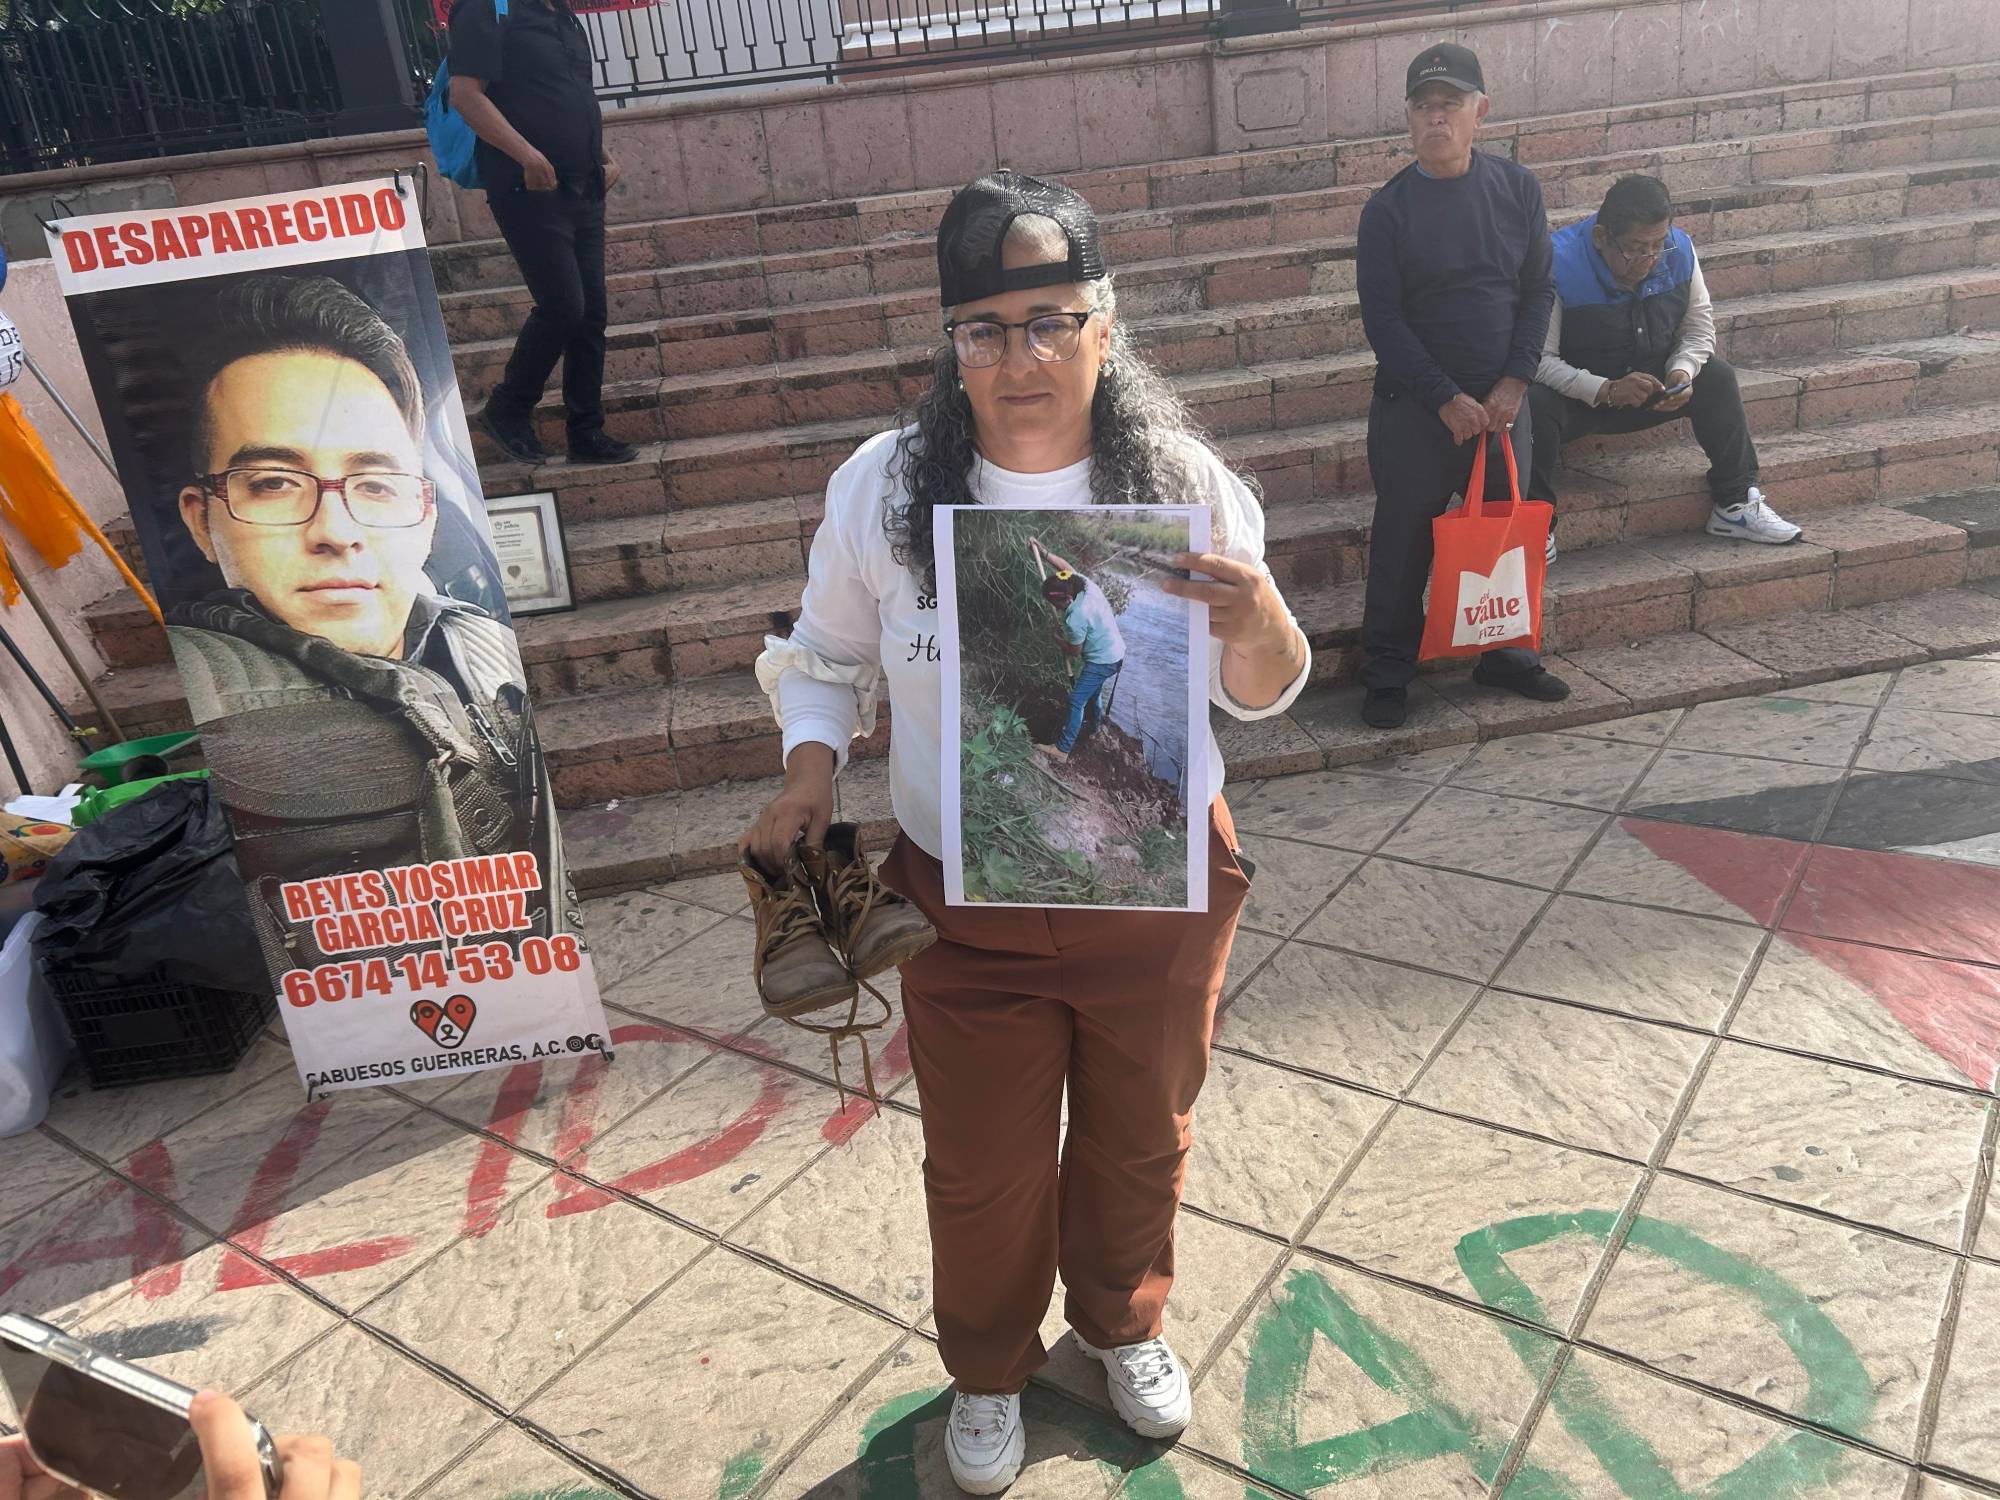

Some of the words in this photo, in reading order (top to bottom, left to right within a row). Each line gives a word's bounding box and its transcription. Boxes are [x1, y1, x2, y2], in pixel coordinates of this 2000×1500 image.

[62, 187, 406, 274] DESAPARECIDO
[1463, 596, 1521, 626] Valle
[1478, 624, 1505, 640] FIZZ
[282, 872, 387, 921] REYES
[386, 853, 540, 904] YOSIMAR
[314, 904, 441, 953] GARCIA
[441, 892, 530, 936] CRUZ
[283, 959, 393, 1008] 6674
[397, 952, 448, 992] 14
[454, 942, 514, 984] 53
[521, 935, 581, 976] 08
[411, 1044, 527, 1074] GUERRERAS,
[532, 1039, 566, 1058] A.C.
